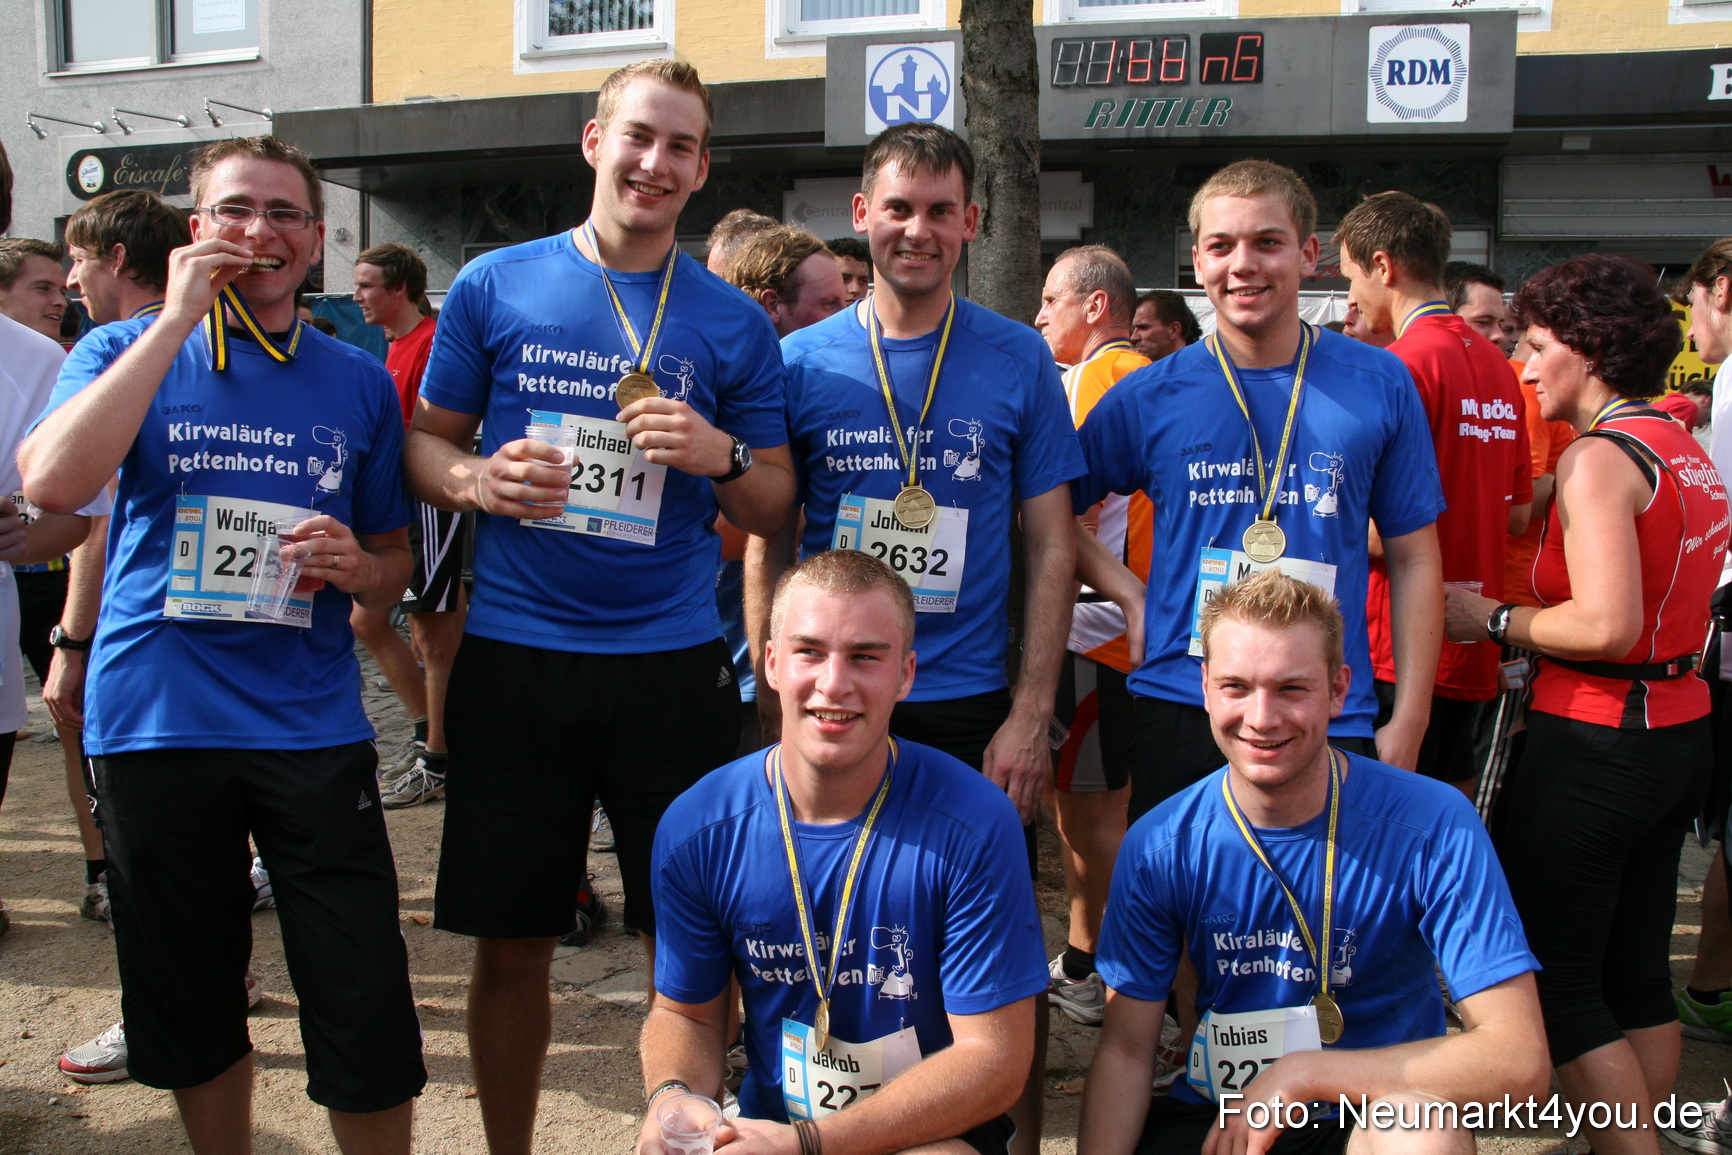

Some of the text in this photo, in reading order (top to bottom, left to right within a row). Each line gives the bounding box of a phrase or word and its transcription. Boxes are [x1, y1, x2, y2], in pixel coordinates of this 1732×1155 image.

[1386, 58, 1452, 86] RDM
[1083, 97, 1233, 129] RITTER
[1039, 197, 1082, 211] entral
[522, 343, 634, 374] Kirwaläufe
[518, 373, 617, 401] Pettenhof
[168, 421, 296, 447] Kirwaläufer
[826, 426, 934, 448] Kirwaläfer
[168, 450, 299, 476] Pettenhofen
[1188, 458, 1297, 481] Kirwalär
[569, 462, 646, 501] 2311
[1189, 485, 1299, 508] Pettenhen
[216, 508, 277, 537] Wolfga
[604, 519, 654, 537] PFLEIDERER
[180, 541, 189, 557] D
[840, 534, 848, 549] D
[870, 541, 949, 577] 2632
[181, 602, 222, 613] BOCK
[913, 595, 955, 606] FLEIDERER
[1211, 1023, 1268, 1046] Tobias
[813, 1048, 860, 1073] Jakob
[789, 1066, 796, 1084] D
